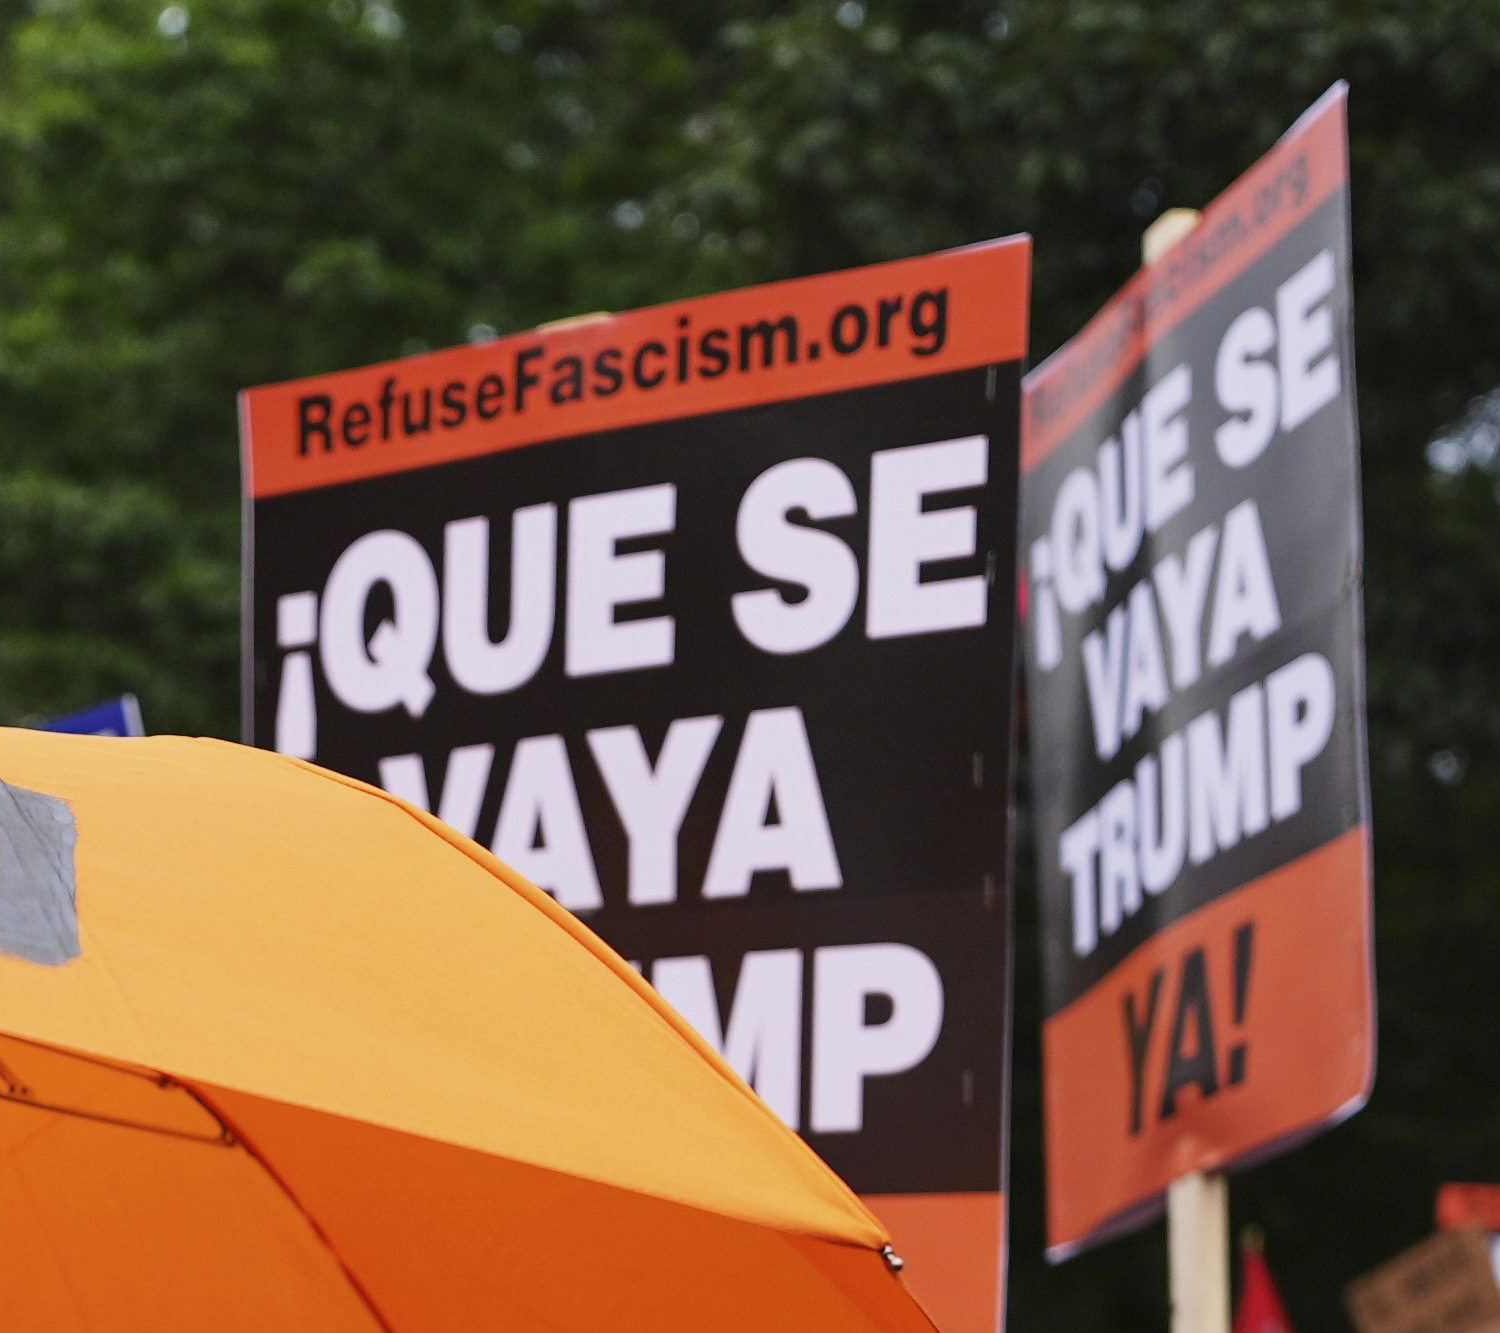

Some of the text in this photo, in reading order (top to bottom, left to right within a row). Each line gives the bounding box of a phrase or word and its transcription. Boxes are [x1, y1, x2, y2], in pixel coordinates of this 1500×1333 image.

[295, 281, 950, 459] RefuseFascism.org
[1031, 247, 1342, 673] ¡QUE SE
[277, 434, 990, 760] ¡QUE SE
[1083, 499, 1282, 762] VAYA
[1060, 653, 1336, 958] TRUMP
[1121, 921, 1257, 1137] YA!
